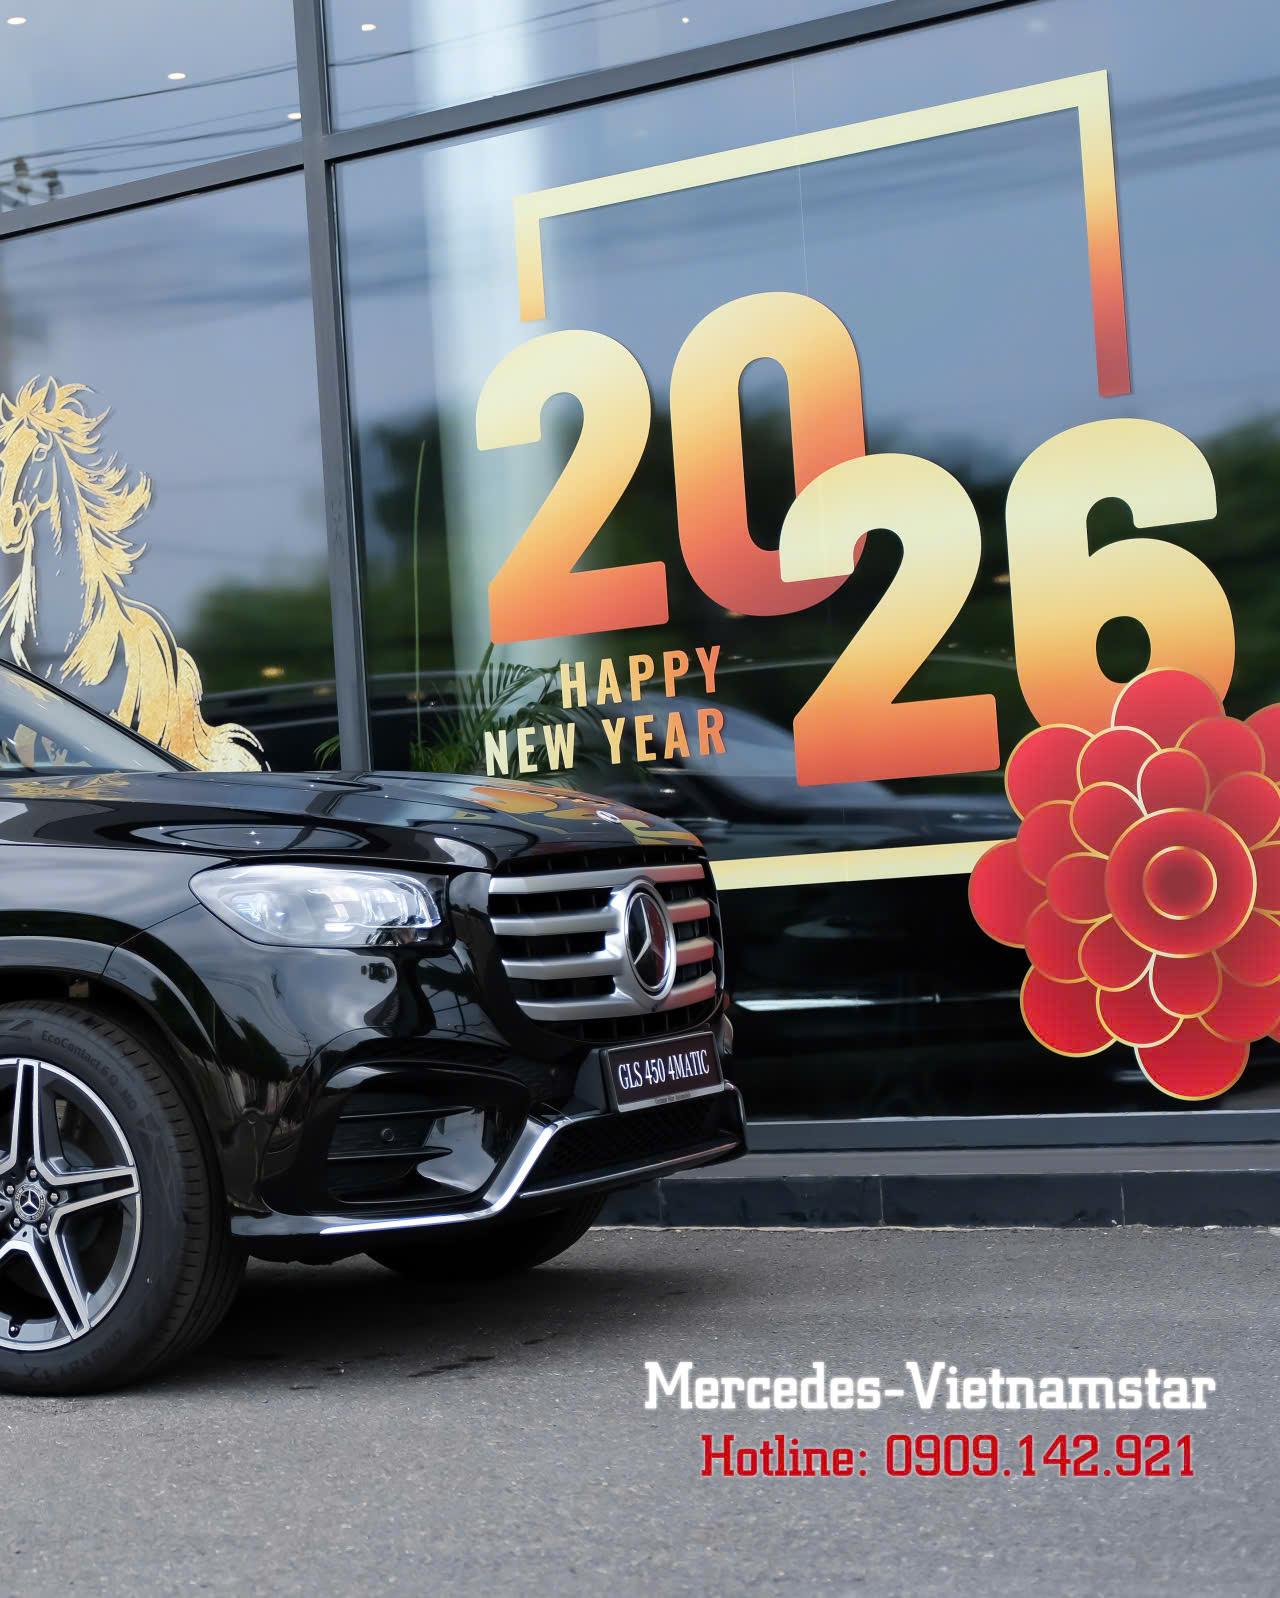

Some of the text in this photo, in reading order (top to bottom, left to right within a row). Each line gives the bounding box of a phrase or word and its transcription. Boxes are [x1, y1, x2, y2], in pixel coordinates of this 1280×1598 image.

[560, 645, 721, 709] HAPPY
[484, 708, 726, 777] NEW YEAR
[41, 1030, 102, 1070] EcoContact
[618, 1049, 710, 1090] GLS 450 4MATIC
